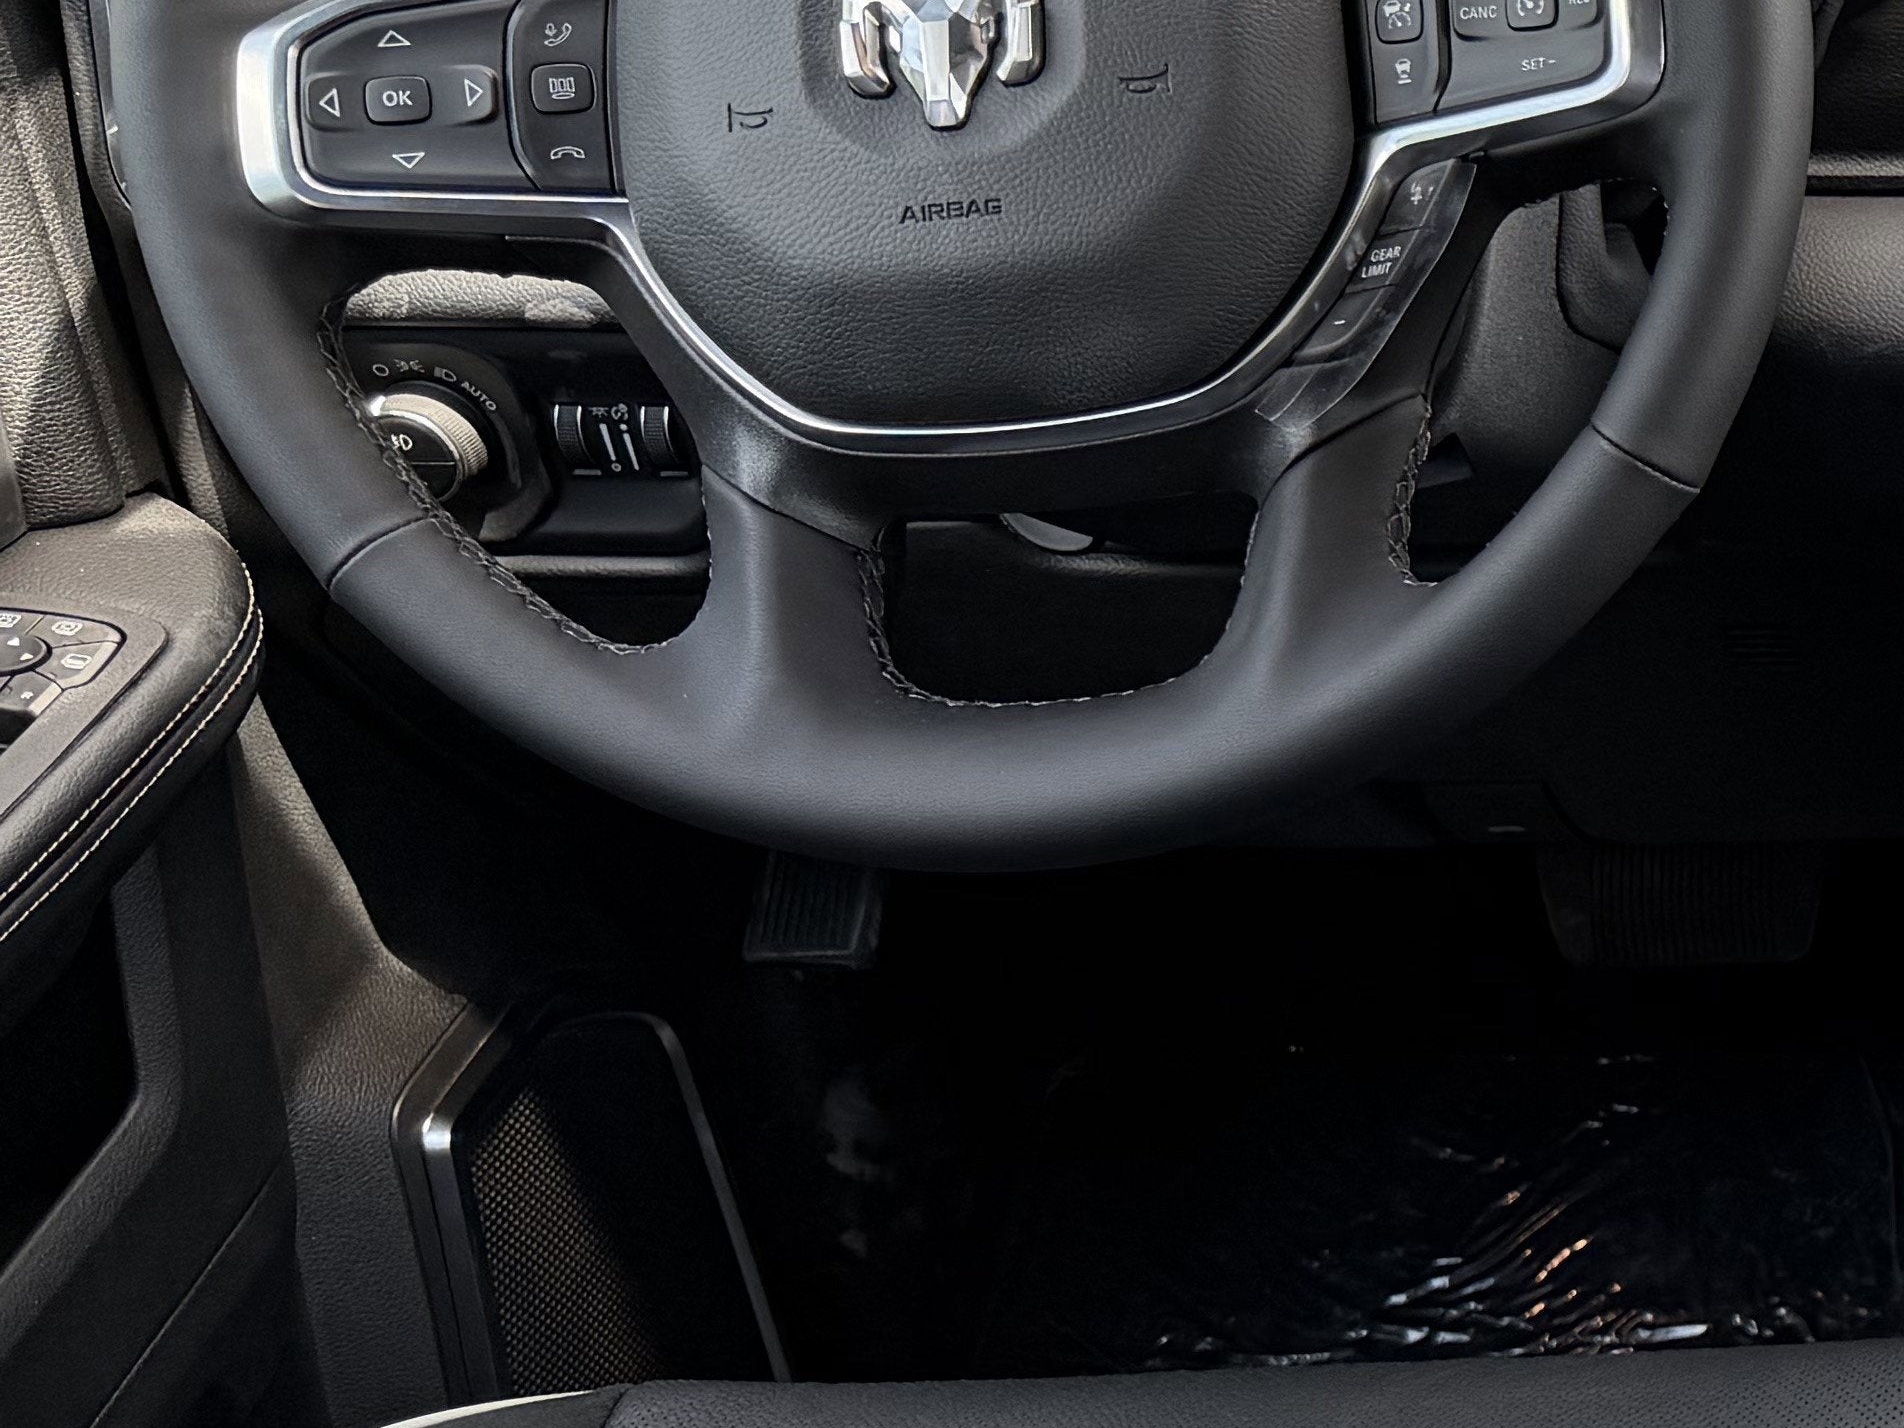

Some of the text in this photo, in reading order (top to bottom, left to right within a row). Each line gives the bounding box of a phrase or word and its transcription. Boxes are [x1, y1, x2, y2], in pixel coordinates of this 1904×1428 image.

[1459, 4, 1497, 21] CANC
[382, 90, 413, 107] OK
[898, 198, 1003, 224] AIRBAG
[1370, 245, 1402, 263] GEAR
[1361, 262, 1393, 279] LIMIT
[460, 380, 498, 412] AUTO
